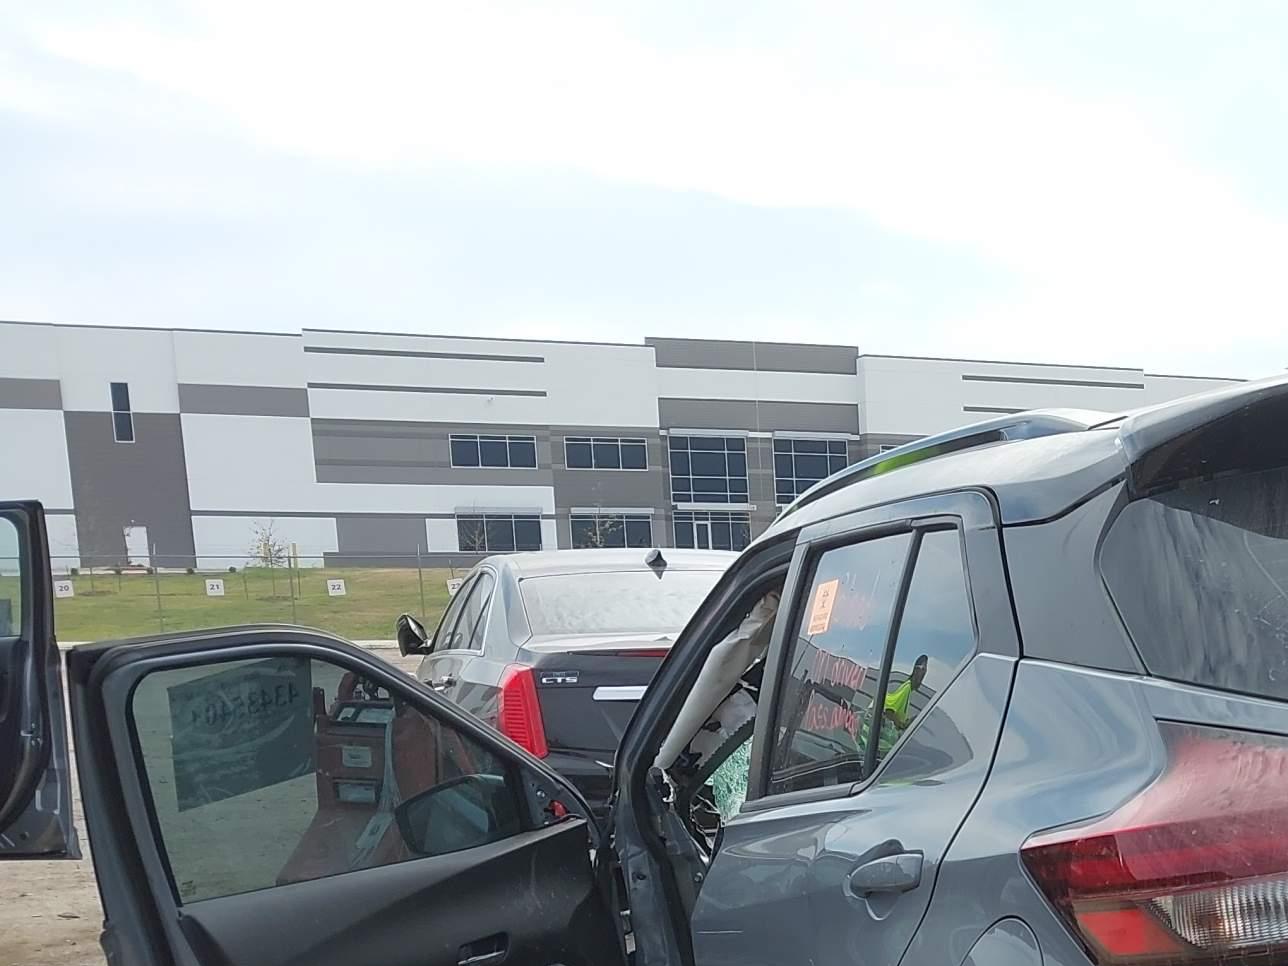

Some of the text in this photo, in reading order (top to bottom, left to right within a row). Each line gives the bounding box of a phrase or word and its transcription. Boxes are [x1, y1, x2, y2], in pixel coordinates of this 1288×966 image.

[209, 583, 220, 591] 21
[330, 583, 342, 591] 22
[541, 676, 579, 684] CTS
